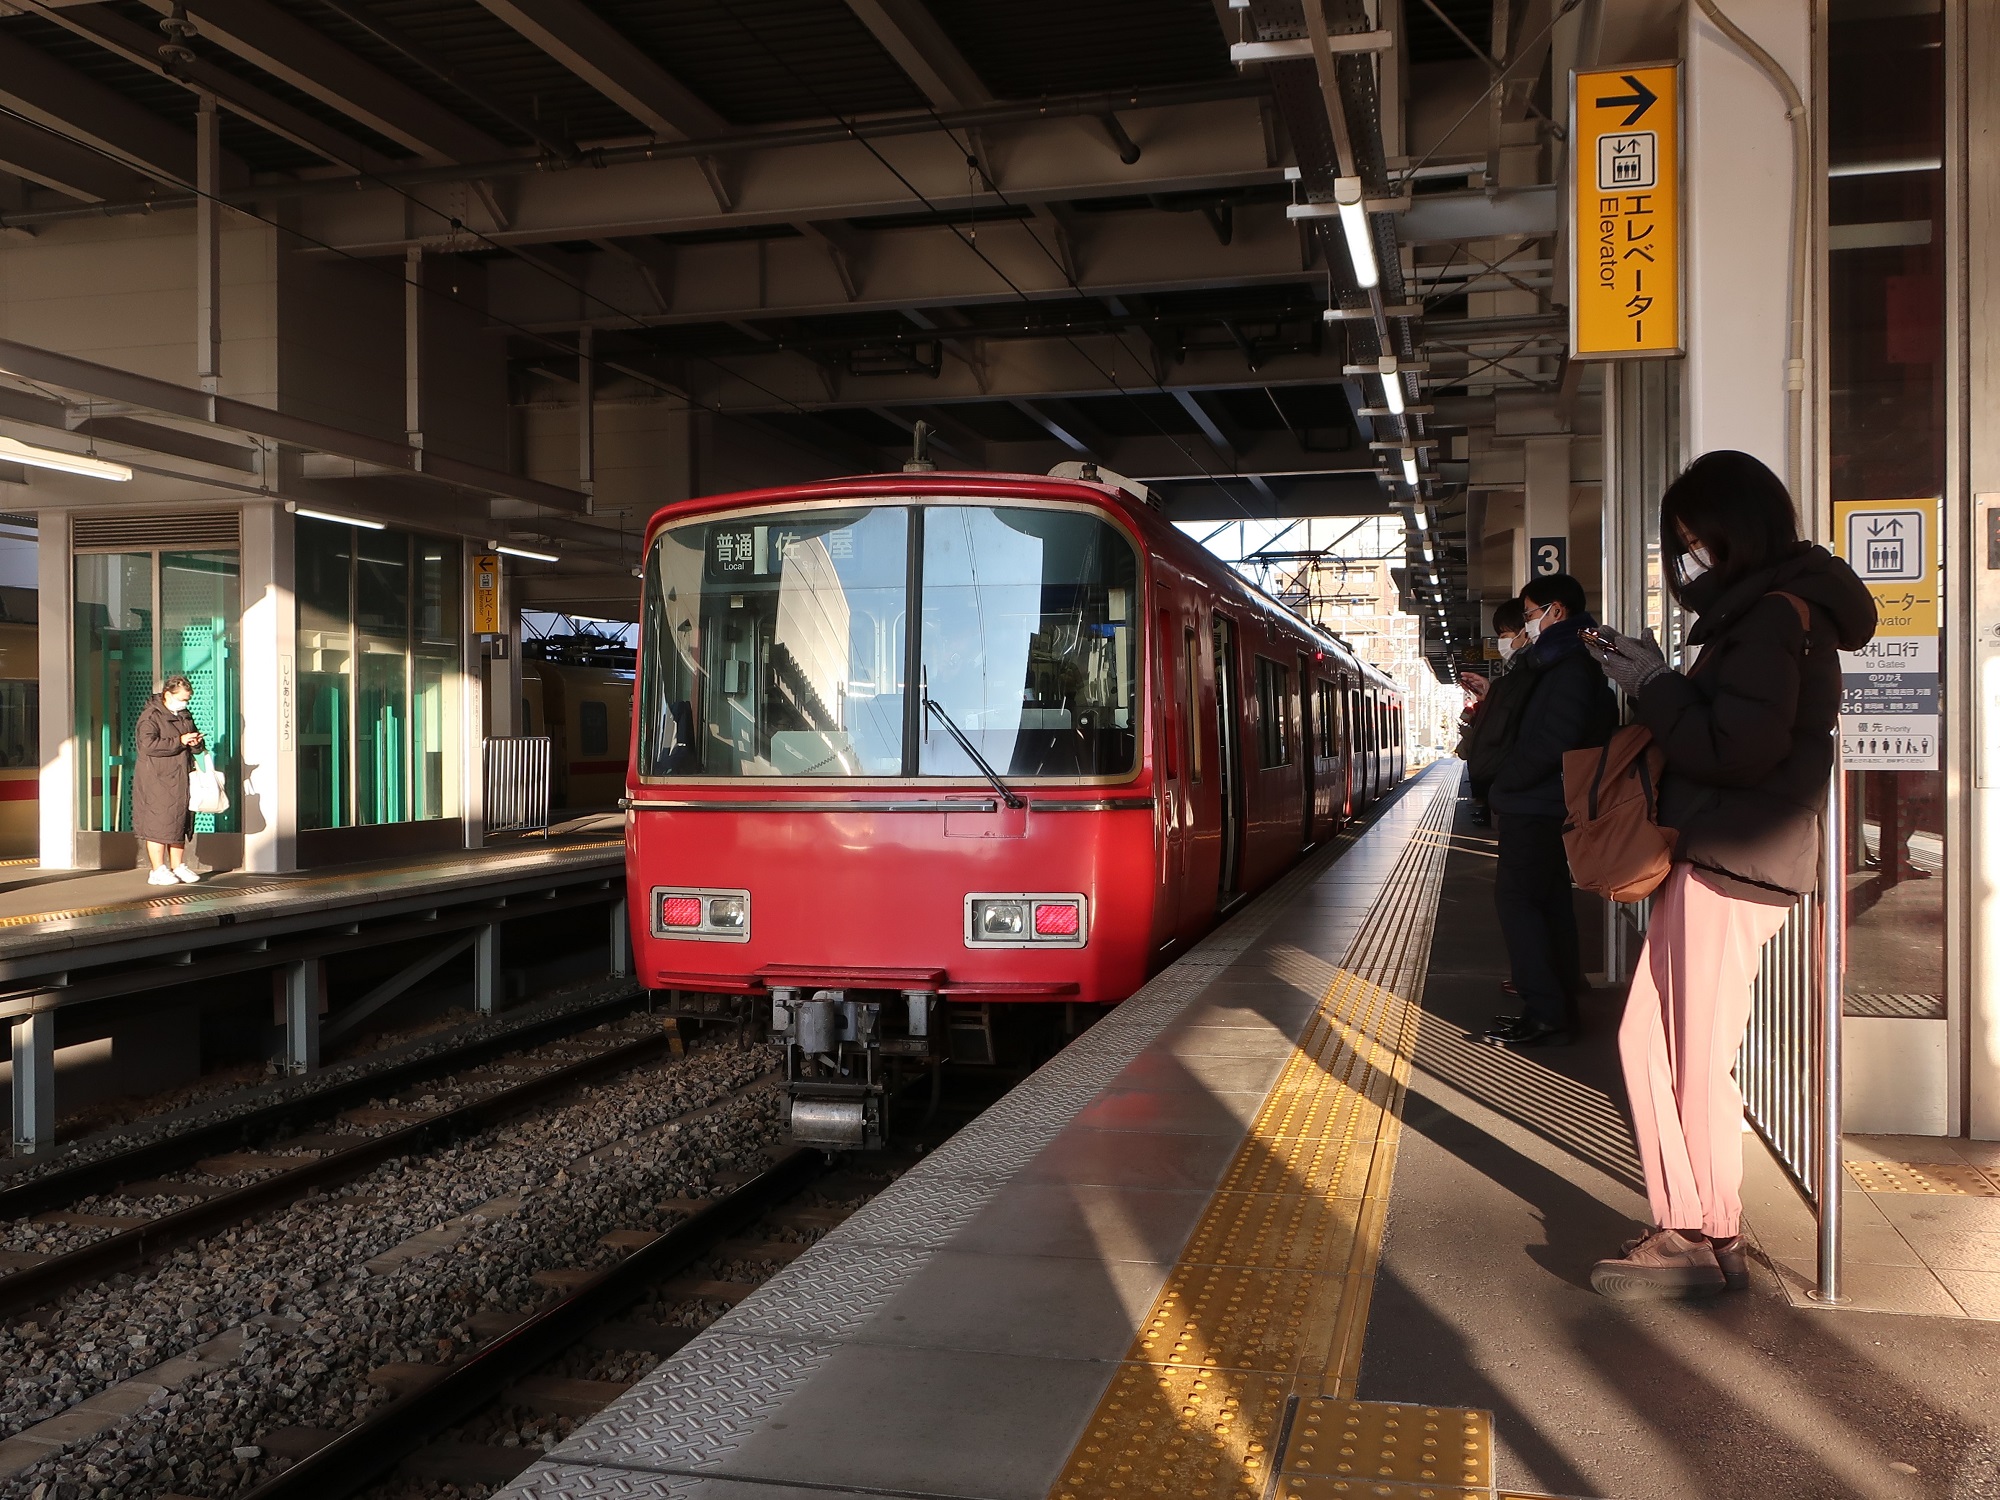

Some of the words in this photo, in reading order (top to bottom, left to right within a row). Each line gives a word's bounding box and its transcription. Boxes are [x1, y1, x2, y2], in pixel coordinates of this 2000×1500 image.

[1599, 197, 1619, 290] Elevator
[1623, 194, 1656, 343] エレベーター
[716, 533, 753, 562] 普通
[723, 561, 745, 571] Local
[1537, 544, 1560, 576] 3
[484, 589, 493, 631] エレベーター
[495, 638, 503, 656] 1
[1866, 661, 1875, 669] to
[1877, 659, 1906, 669] Gates
[1868, 673, 1903, 682] のりかえ
[1885, 725, 1912, 734] Priority
